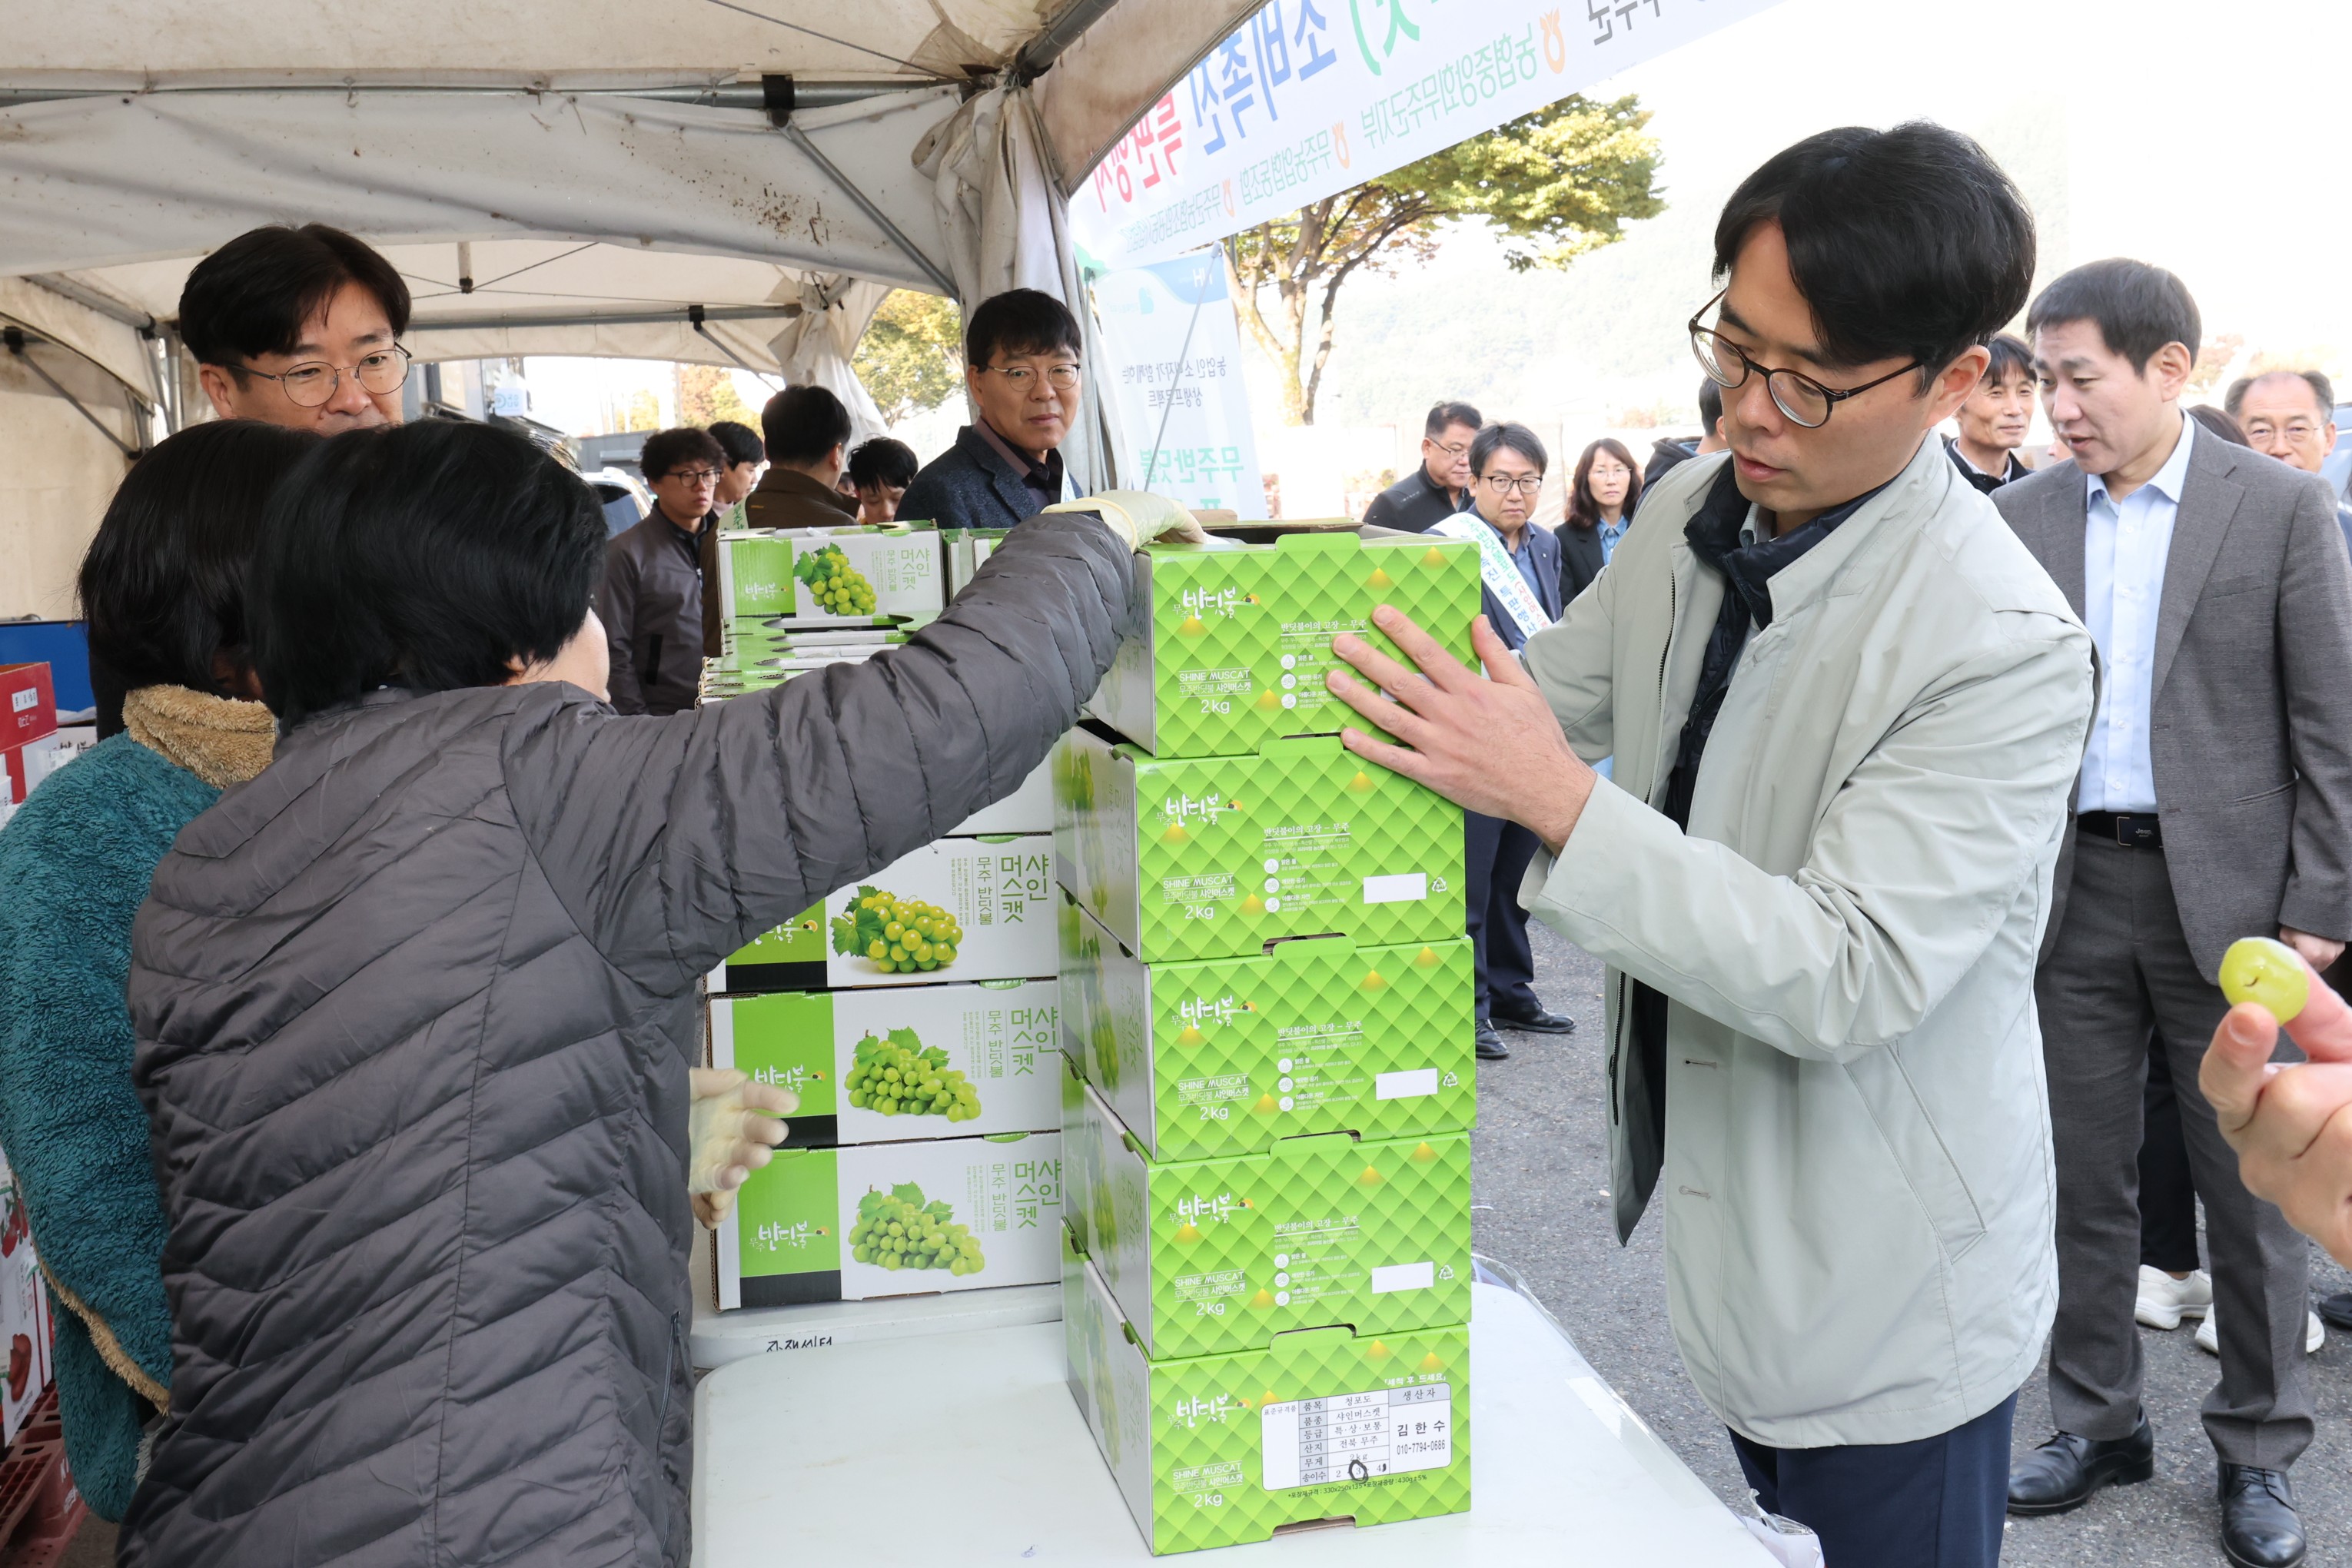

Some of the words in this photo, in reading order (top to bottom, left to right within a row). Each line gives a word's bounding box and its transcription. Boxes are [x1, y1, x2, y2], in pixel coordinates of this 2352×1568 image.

[887, 550, 895, 566] 무주
[916, 548, 930, 576] 샤인
[901, 548, 915, 590] 머스켓
[1172, 604, 1190, 621] 무주
[1183, 586, 1238, 620] 반딧불
[1281, 621, 1321, 631] 반딧불이의
[1322, 620, 1339, 630] 고장
[1350, 620, 1367, 629] 무주
[1179, 672, 1206, 682] SHINE
[1210, 669, 1250, 680] MUSCAT
[1179, 683, 1214, 694] 무주반딧불
[1216, 682, 1251, 692] 샤인머스켓
[1156, 812, 1173, 829] 무주
[1166, 793, 1221, 827] 반딧불
[1264, 826, 1304, 836] 반딧불이의
[1306, 824, 1321, 833] 고장
[1333, 822, 1350, 832] 무주
[977, 857, 992, 882] 무주
[1026, 854, 1049, 901] 샤인
[1001, 855, 1024, 923] 머스캣
[1163, 879, 1190, 889] SHINE
[1193, 875, 1233, 886] MUSCAT
[1163, 891, 1198, 901] 무주반딧불
[1200, 888, 1234, 898] 샤인머스켓
[978, 887, 993, 925] 반딧불
[1171, 1015, 1188, 1031] 무주
[1181, 995, 1235, 1029] 반딧불
[988, 1010, 1002, 1035] 무주
[1035, 1006, 1058, 1054] 샤인
[1277, 1025, 1317, 1036] 반딧불이의
[1320, 1023, 1334, 1031] 고장
[1346, 1021, 1362, 1030] 무주
[1011, 1008, 1034, 1075] 머스켓
[988, 1039, 1004, 1078] 반딧불
[1178, 1081, 1204, 1091] SHINE
[1208, 1076, 1247, 1087] MUSCAT
[1178, 1092, 1212, 1103] 무주반딧불
[1214, 1087, 1249, 1098] 샤인머스켓
[992, 1164, 1006, 1189] 무주
[1038, 1158, 1061, 1206] 샤인
[1015, 1161, 1038, 1229] 머스켓
[992, 1193, 1008, 1231] 반딧불
[1168, 1213, 1185, 1228] 무주
[1178, 1192, 1233, 1227] 반딧불
[1274, 1221, 1313, 1232] 반딧불이의
[1317, 1218, 1330, 1227] 고장
[1342, 1216, 1358, 1224] 무주
[749, 1237, 766, 1252] 무주
[759, 1220, 810, 1251] 반딧불
[1175, 1277, 1201, 1287] SHINE
[1204, 1272, 1244, 1284] MUSCAT
[1175, 1288, 1209, 1299] 무주반딧불
[1211, 1283, 1245, 1294] 샤인머스켓
[1403, 1387, 1436, 1401] 생산자
[1176, 1393, 1231, 1427] 반딧불
[1264, 1405, 1297, 1416] 표준규격품
[1304, 1400, 1322, 1411] 품목
[1346, 1395, 1371, 1407] 청포도
[1304, 1416, 1322, 1426] 품종
[1337, 1407, 1380, 1421] 샤인머스켓
[1304, 1429, 1323, 1440] 등급
[1304, 1443, 1323, 1453] 산지
[1340, 1439, 1357, 1449] 전북
[1360, 1436, 1378, 1446] 무주
[1397, 1440, 1445, 1455] 010-7794-0686
[1305, 1457, 1323, 1467] 무게
[1173, 1469, 1199, 1480] SHINE
[1203, 1463, 1241, 1475] MUSCAT
[1303, 1472, 1327, 1482] 송이수
[1173, 1480, 1207, 1492] 무주반딧불
[1209, 1474, 1243, 1486] 샤인머스켓
